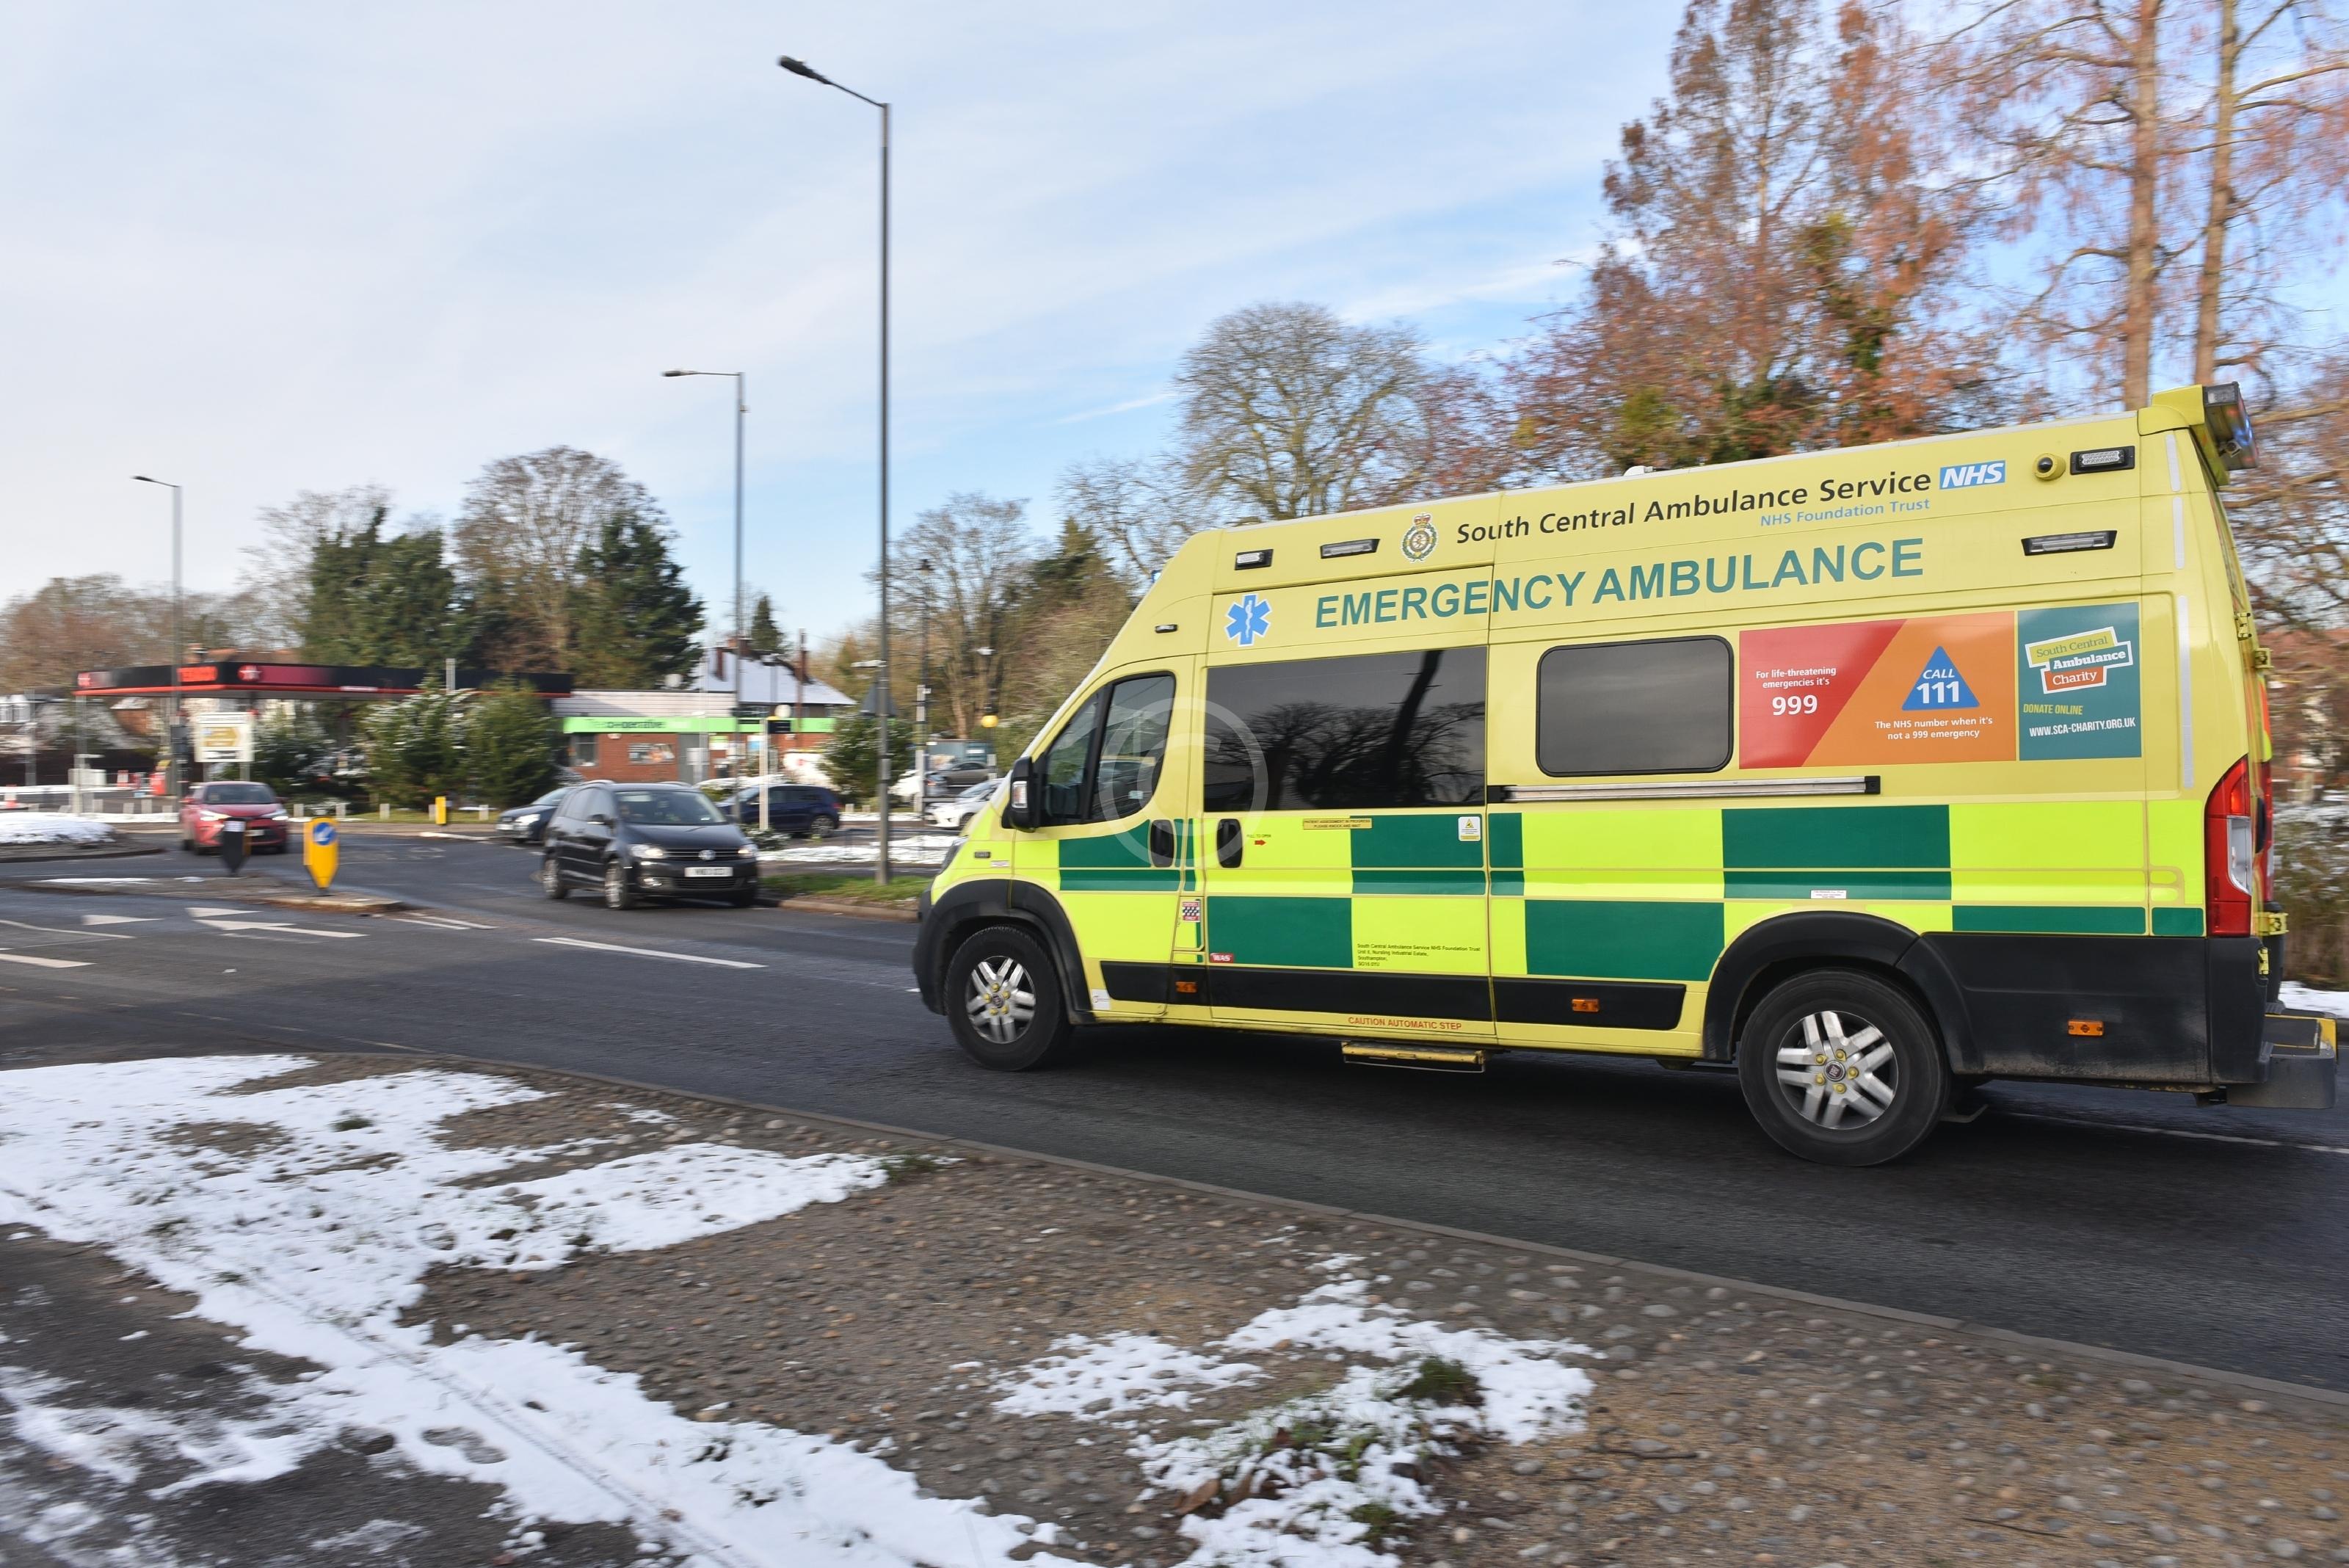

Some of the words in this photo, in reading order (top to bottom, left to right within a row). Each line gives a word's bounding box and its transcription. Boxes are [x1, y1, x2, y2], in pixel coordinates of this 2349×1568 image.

[1457, 516, 1529, 544] South
[1539, 503, 1635, 534] Central
[1644, 489, 1808, 523] Ambulance
[1820, 471, 1931, 502] Service
[1942, 462, 2004, 488] NHS
[1760, 513, 1792, 526] NHS
[1796, 504, 1884, 523] Foundation
[1889, 498, 1931, 513] Trust
[1315, 572, 1586, 628] EMERGENCY
[1593, 538, 1925, 603] AMBULANCE
[2036, 645, 2067, 658] South
[2069, 636, 2109, 650] Central
[2053, 650, 2127, 669] Ambulance
[1771, 667, 1837, 678] life-threatening
[1923, 668, 1956, 679] CALL
[2052, 671, 2098, 686] Charity
[1762, 678, 1815, 689] emergencies
[1816, 677, 1830, 686] it's
[1916, 680, 1959, 704] 111
[1772, 694, 1818, 716] 999
[2023, 703, 2054, 714] DONATE
[2055, 704, 2084, 715] ONLINE
[1875, 721, 1891, 729] The
[1893, 719, 1912, 728] NHS
[1914, 718, 1949, 727] number
[1951, 717, 1977, 725] when
[1979, 716, 1993, 725] it's
[2029, 717, 2136, 737] WWW.SCA-CHARITY.ORG.UK
[1887, 732, 1903, 740] not
[1912, 730, 1928, 738] 999
[1931, 730, 1980, 739] emergency
[1348, 1017, 1385, 1026] CAUTION
[1387, 1018, 1437, 1029] AUTOMATIC
[1439, 1022, 1462, 1030] STEP
